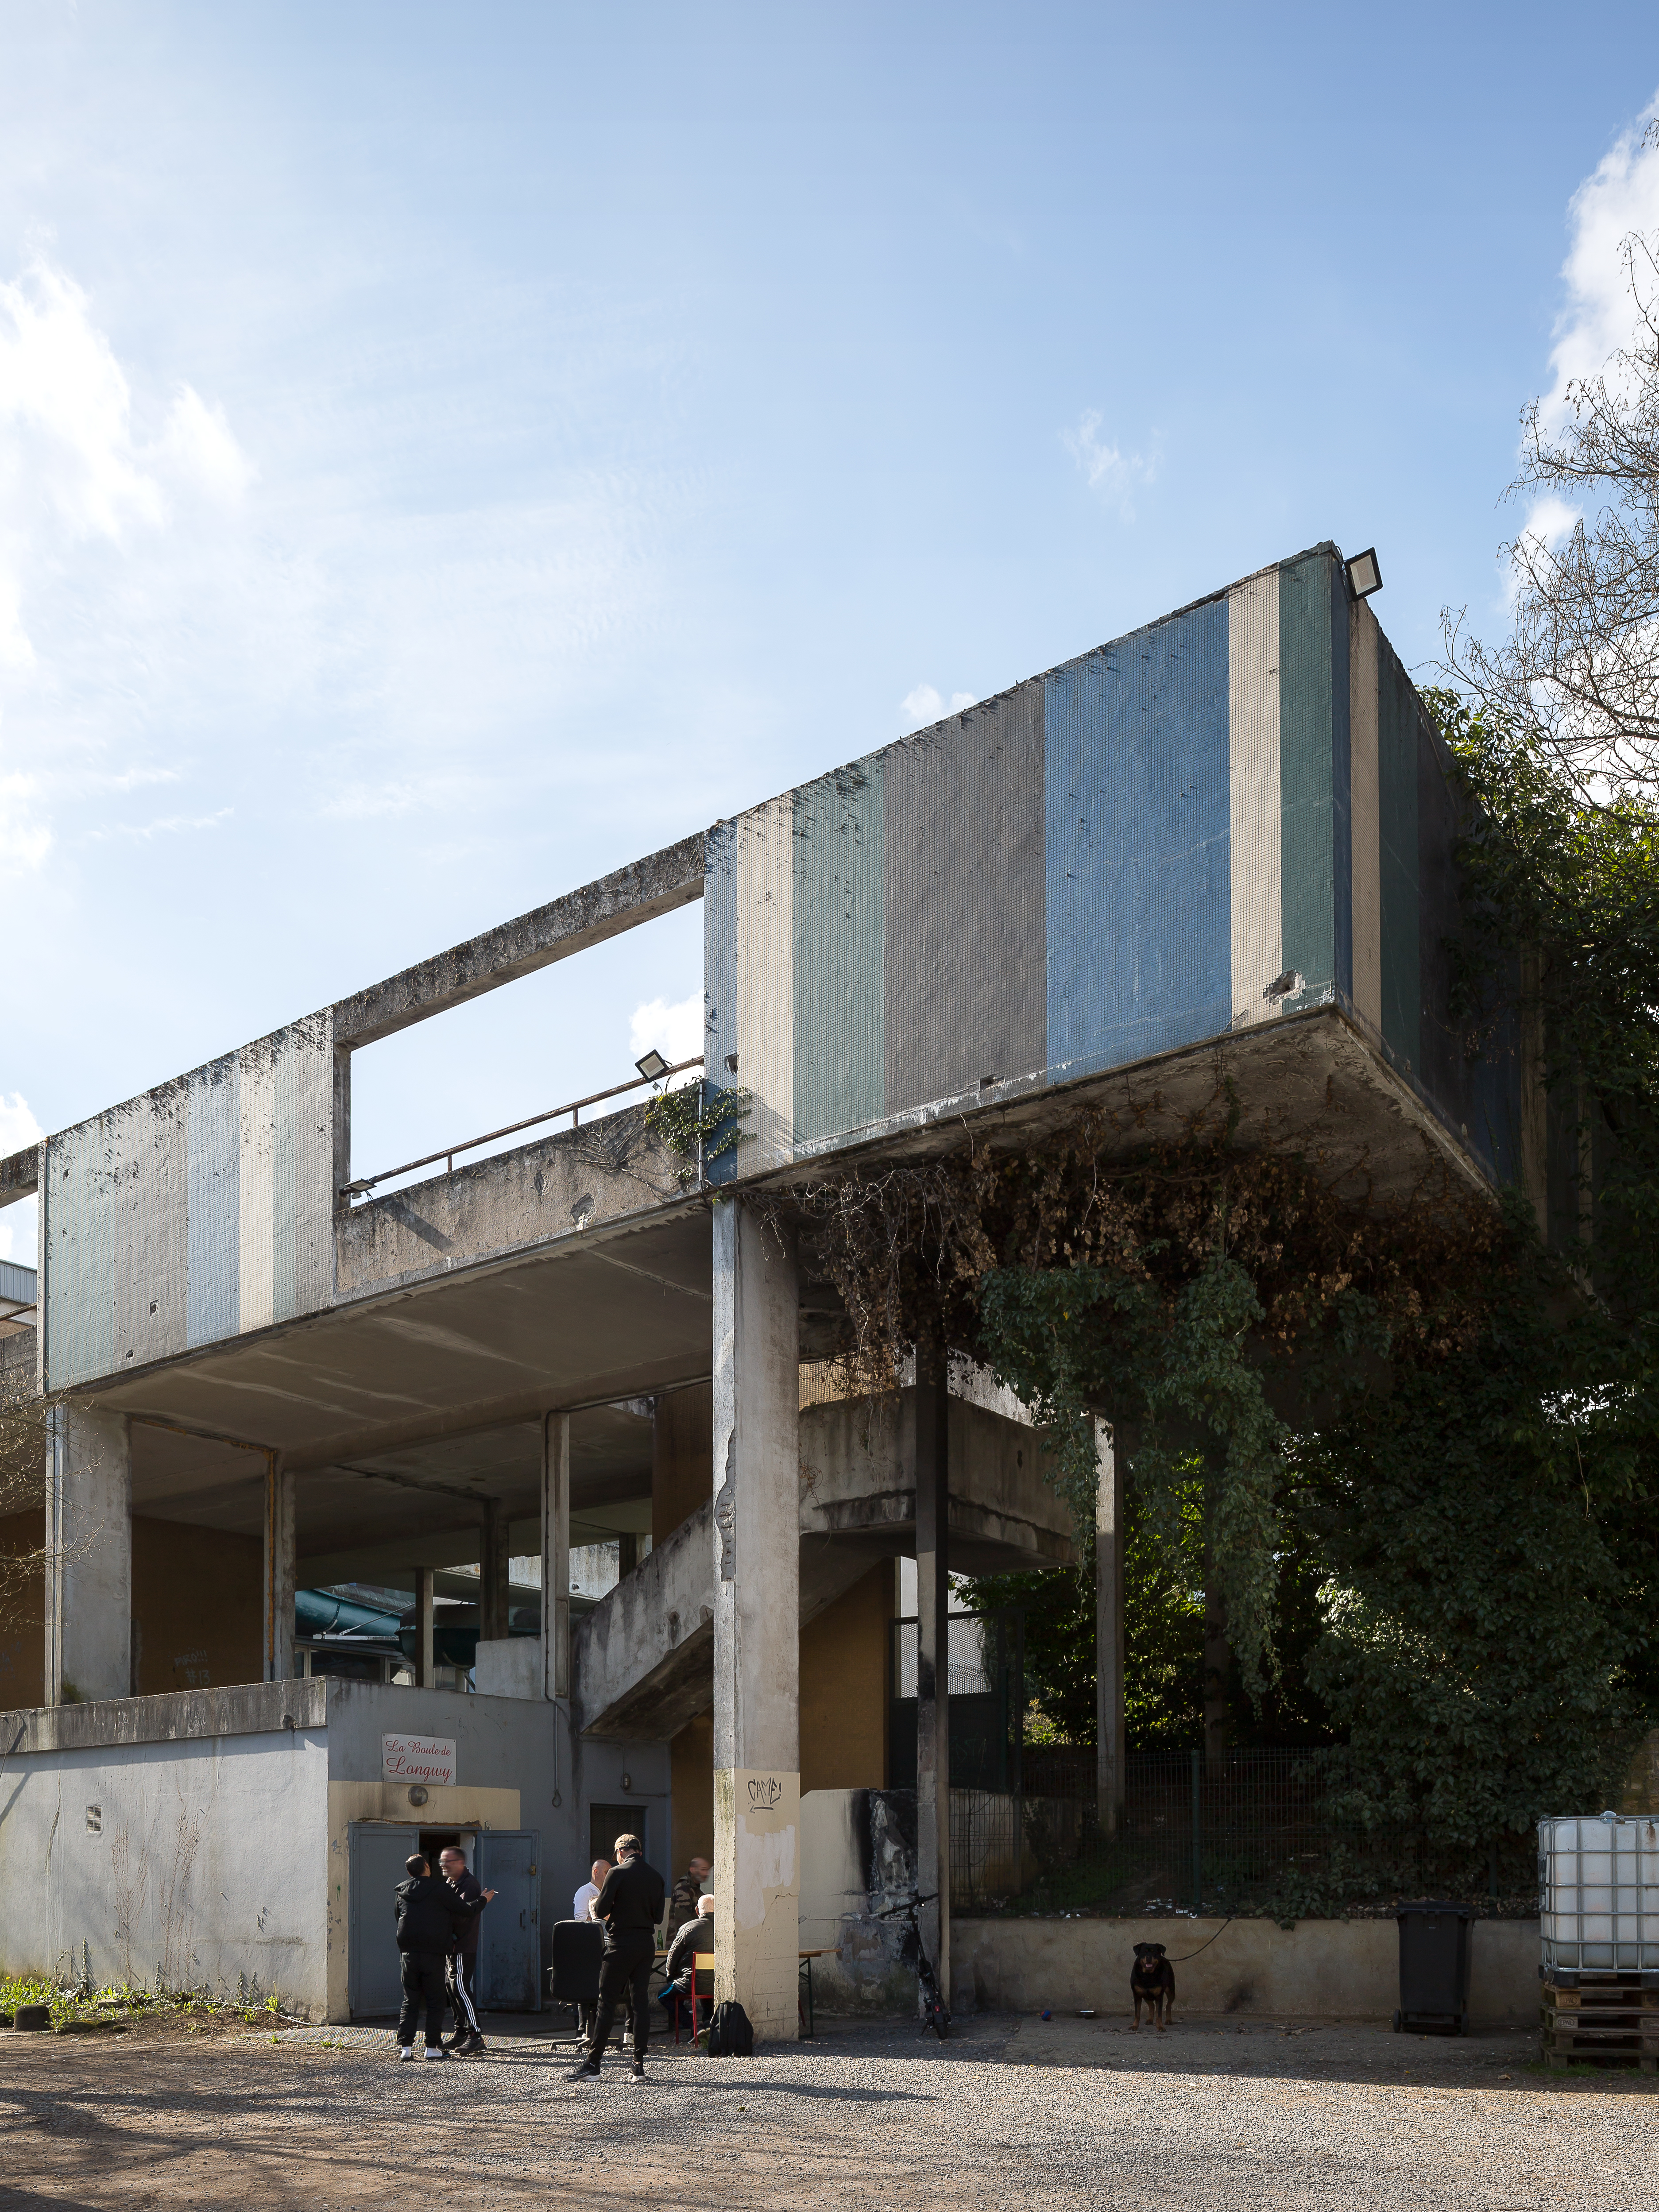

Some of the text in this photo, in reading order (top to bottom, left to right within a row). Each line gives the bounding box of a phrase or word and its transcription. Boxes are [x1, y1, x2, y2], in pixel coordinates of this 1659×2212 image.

[185, 1668, 210, 1685] #13
[386, 1740, 452, 1756] La Boule de
[386, 1756, 452, 1783] Longwy
